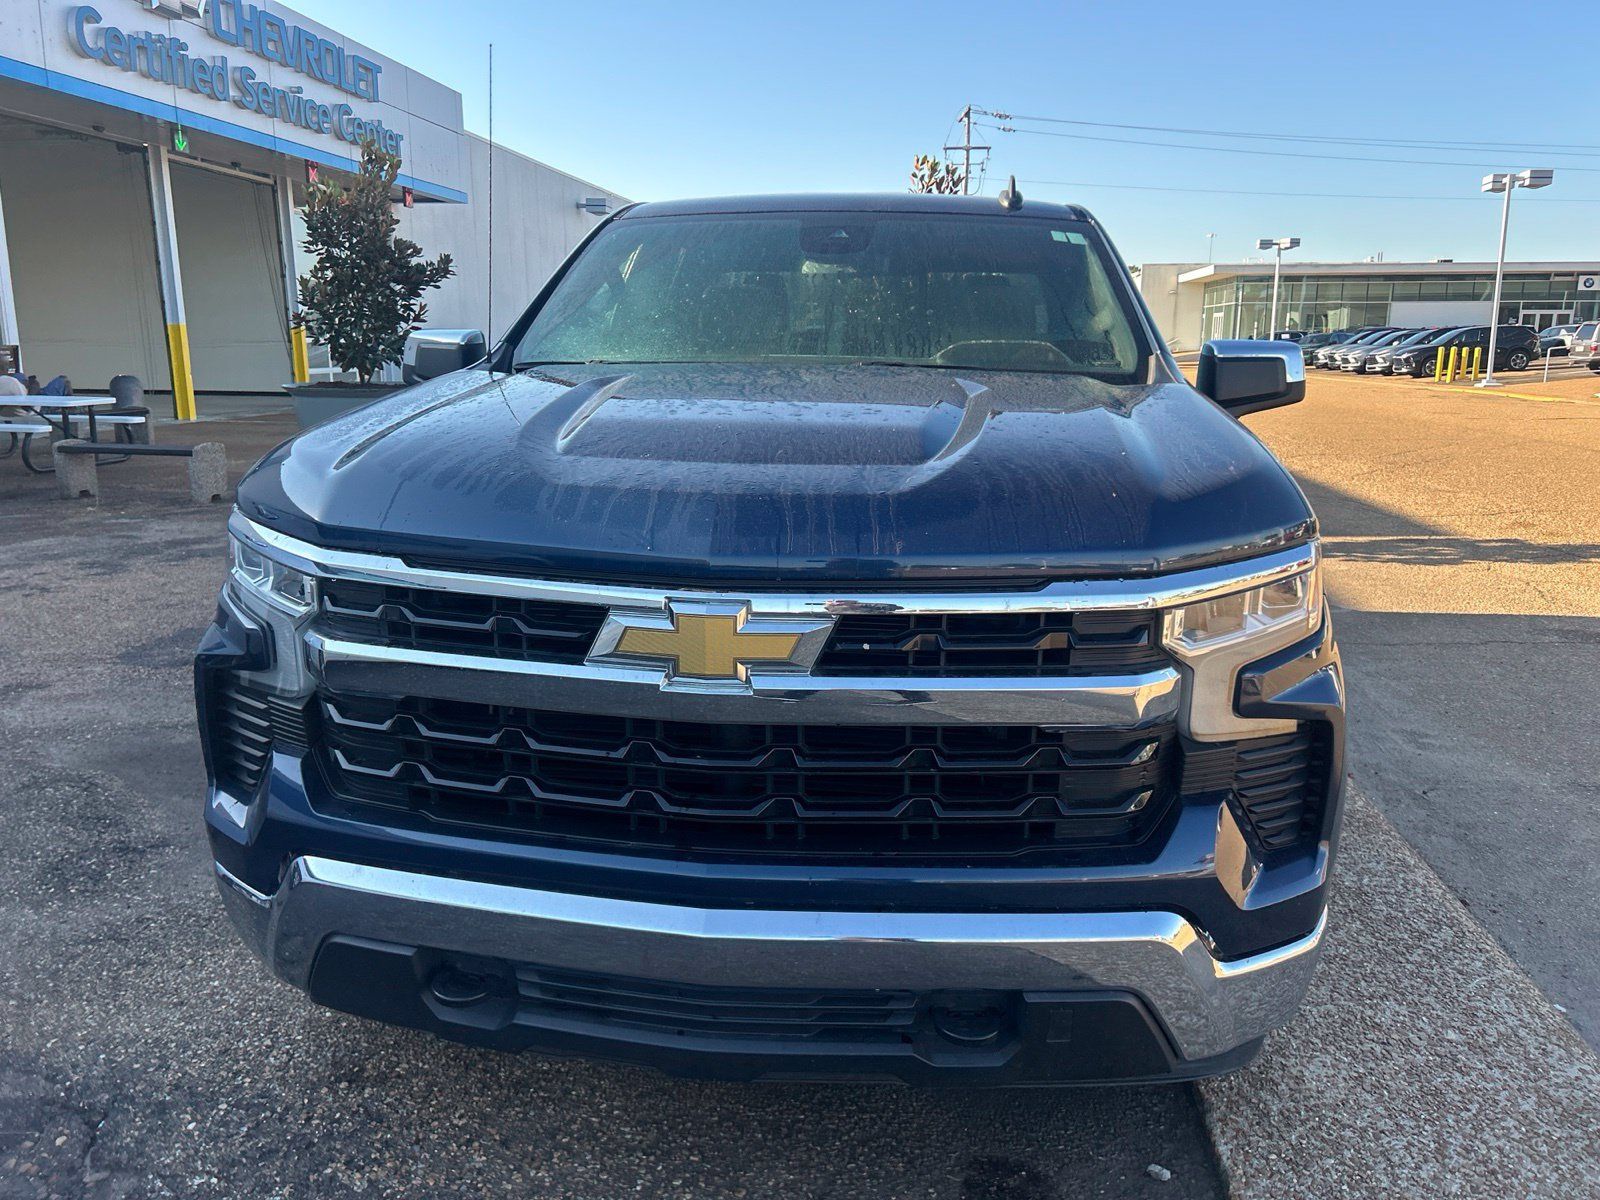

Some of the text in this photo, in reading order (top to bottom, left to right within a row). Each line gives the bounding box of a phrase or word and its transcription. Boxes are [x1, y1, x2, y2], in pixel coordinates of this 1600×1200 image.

[68, 5, 403, 157] Certified Service Center
[207, 0, 382, 102] CHEVROLET
